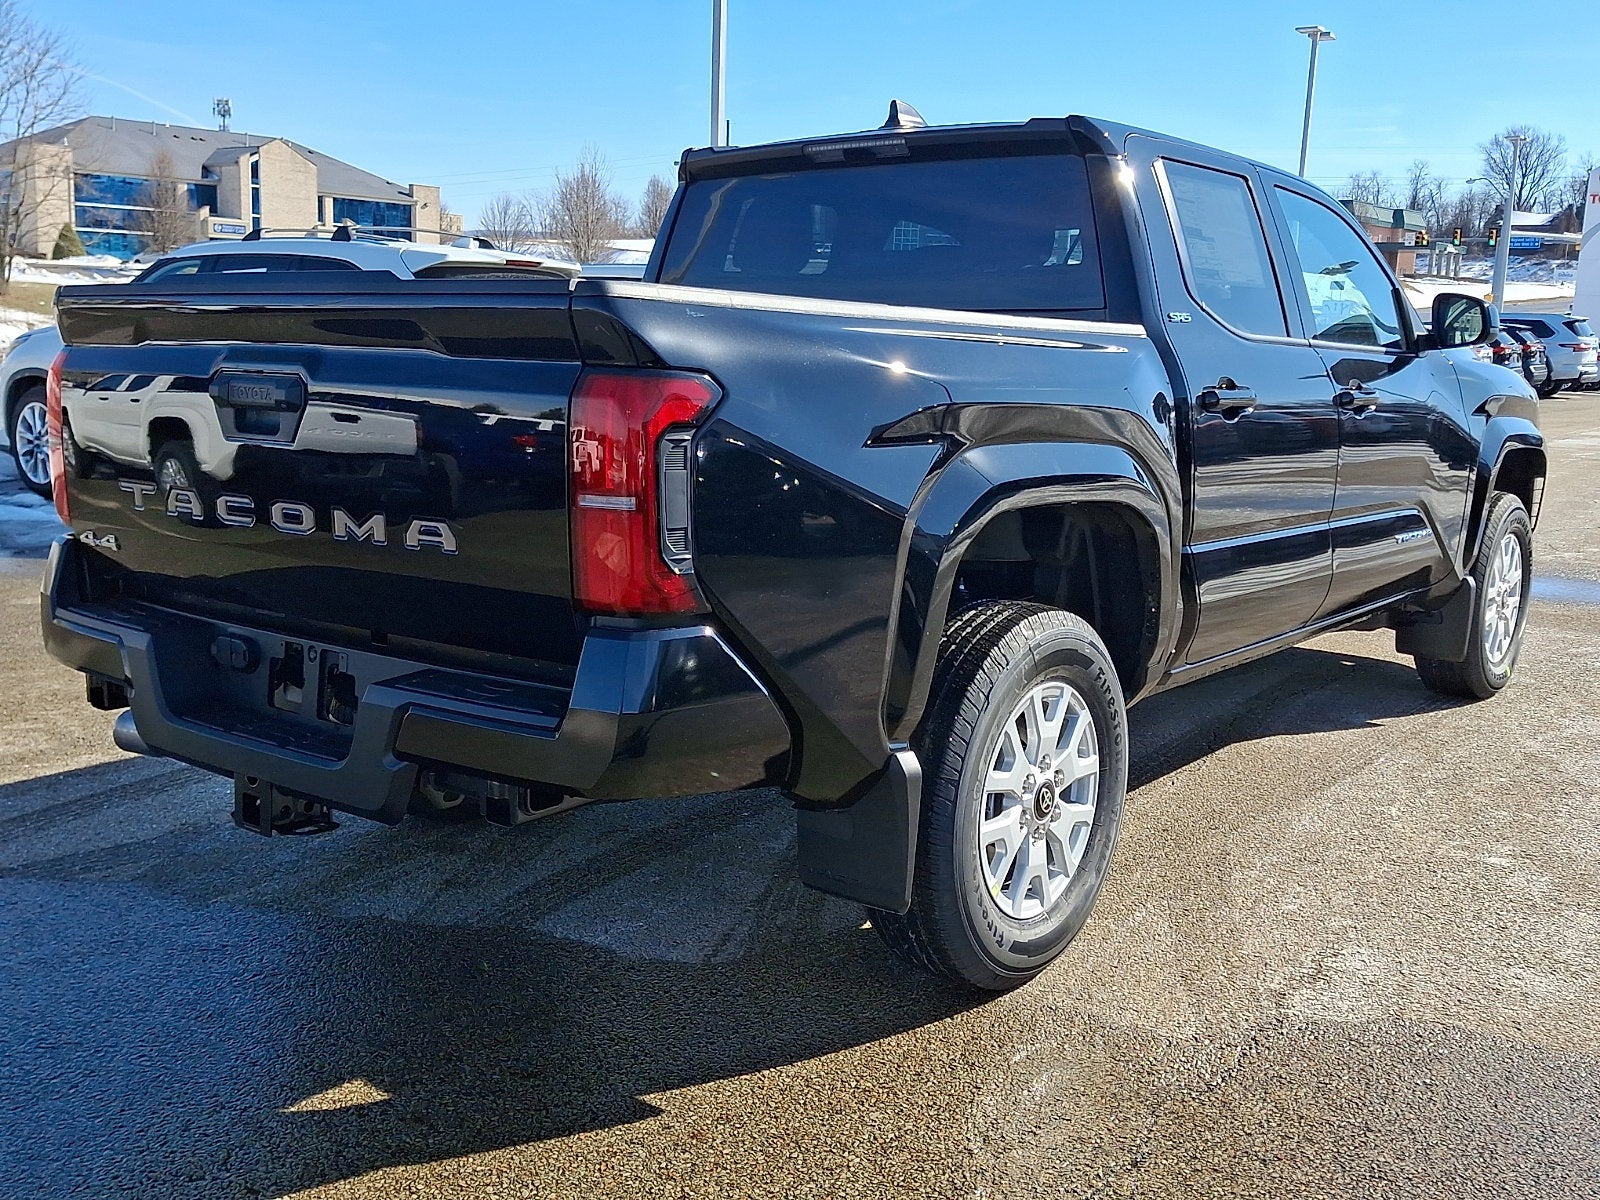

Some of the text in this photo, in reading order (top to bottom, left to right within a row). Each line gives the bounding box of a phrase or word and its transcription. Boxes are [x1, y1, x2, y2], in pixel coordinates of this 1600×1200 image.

[1167, 312, 1191, 323] SR5
[233, 386, 272, 400] TOYOTA
[118, 478, 459, 555] TACOMA
